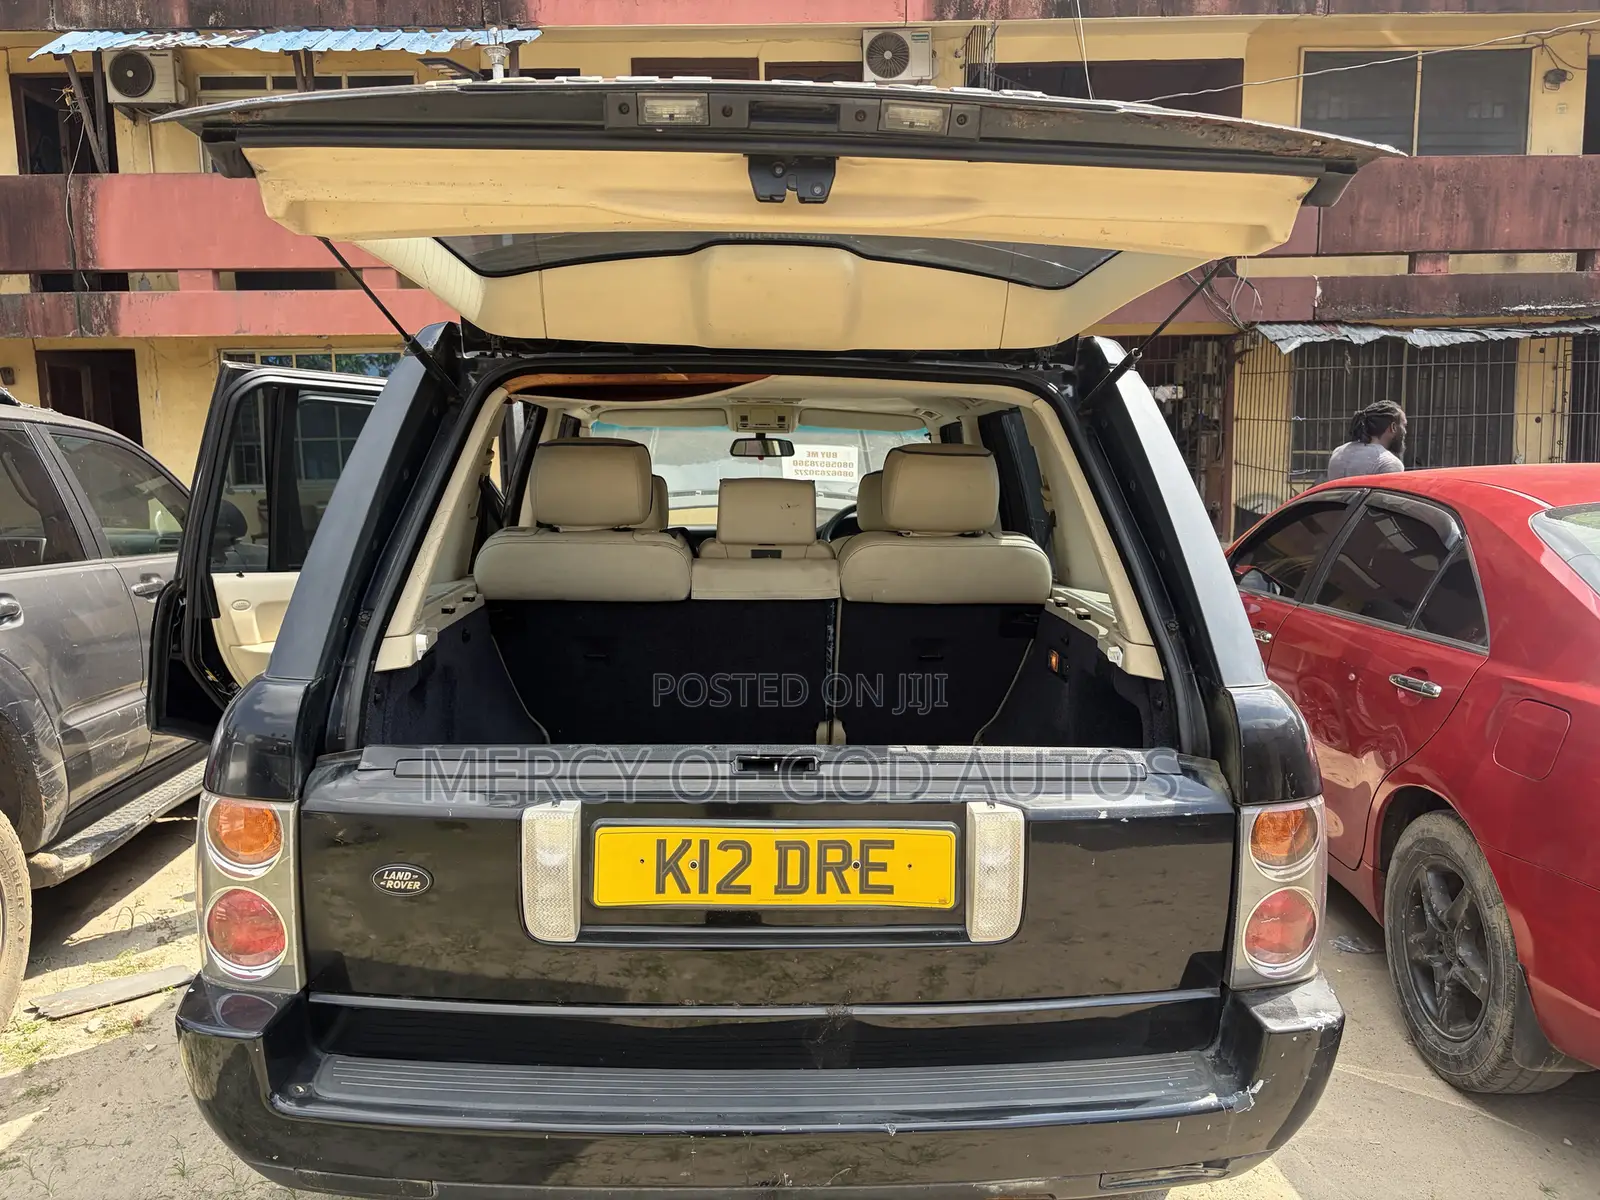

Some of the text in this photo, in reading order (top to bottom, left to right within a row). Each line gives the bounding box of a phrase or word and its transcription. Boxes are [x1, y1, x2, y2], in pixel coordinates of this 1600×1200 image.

[655, 838, 895, 895] K12 DRE
[383, 871, 411, 880] LAND
[386, 880, 421, 890] ROVER
